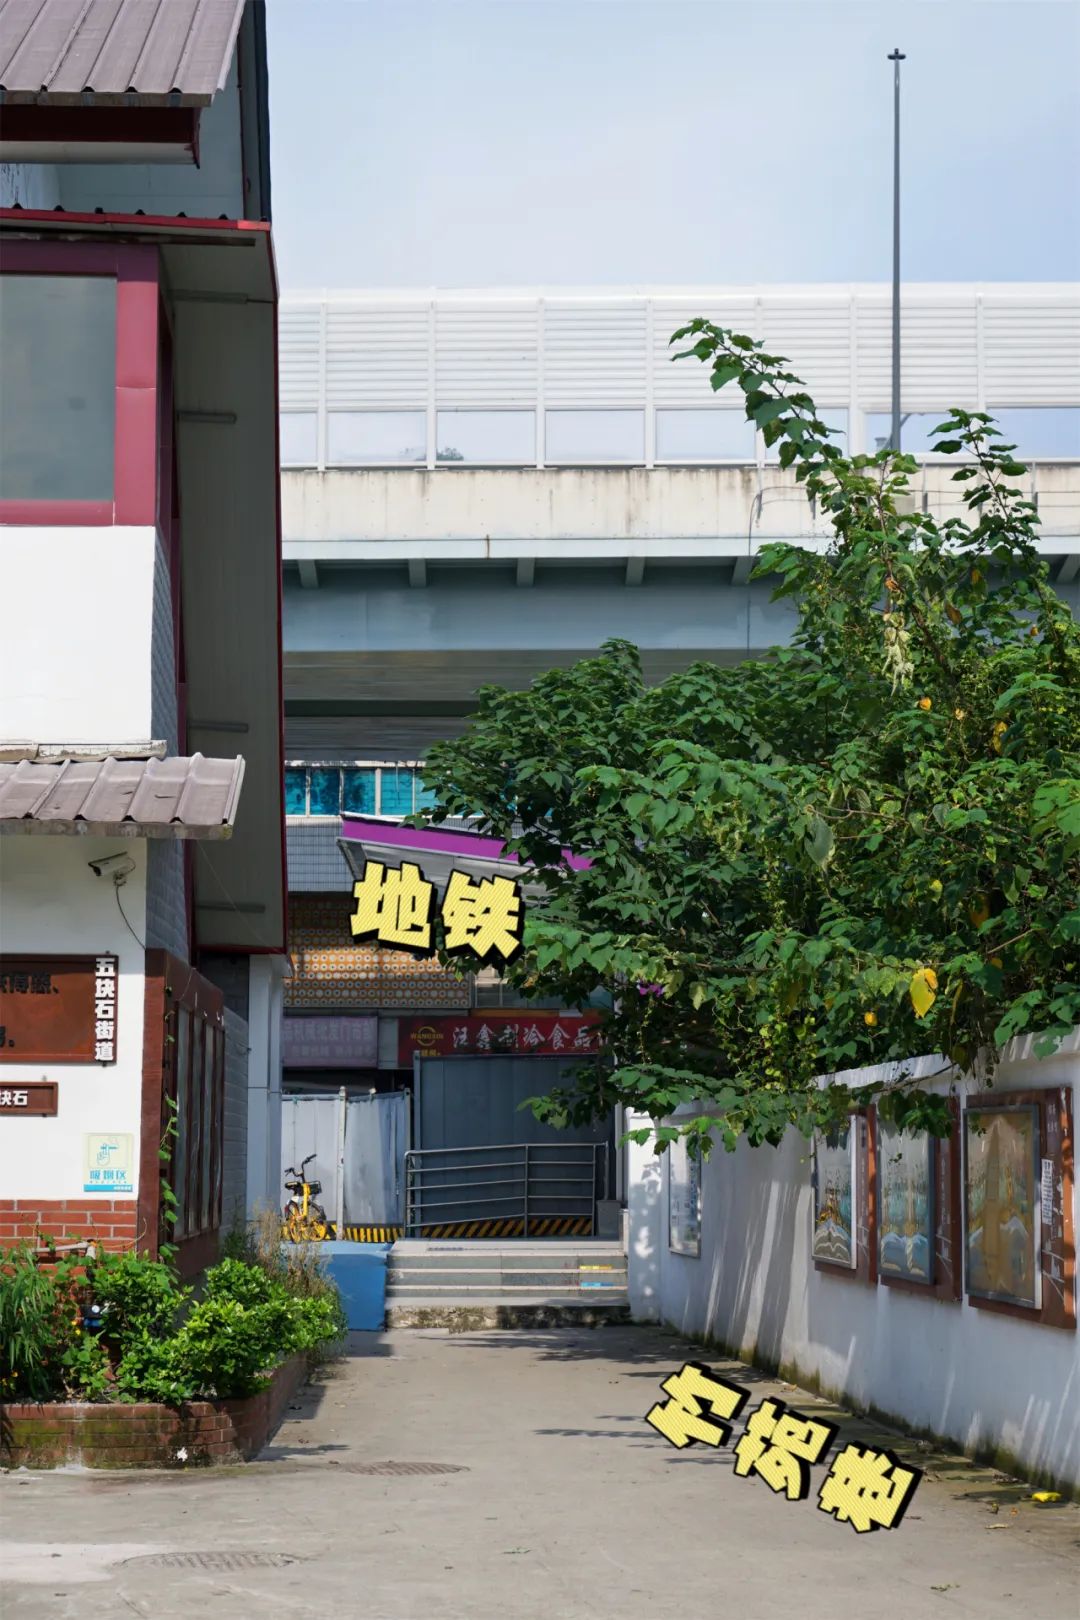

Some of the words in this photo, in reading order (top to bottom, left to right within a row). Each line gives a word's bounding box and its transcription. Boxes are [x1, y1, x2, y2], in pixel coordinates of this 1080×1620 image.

[95, 957, 116, 1062] 五块石街道
